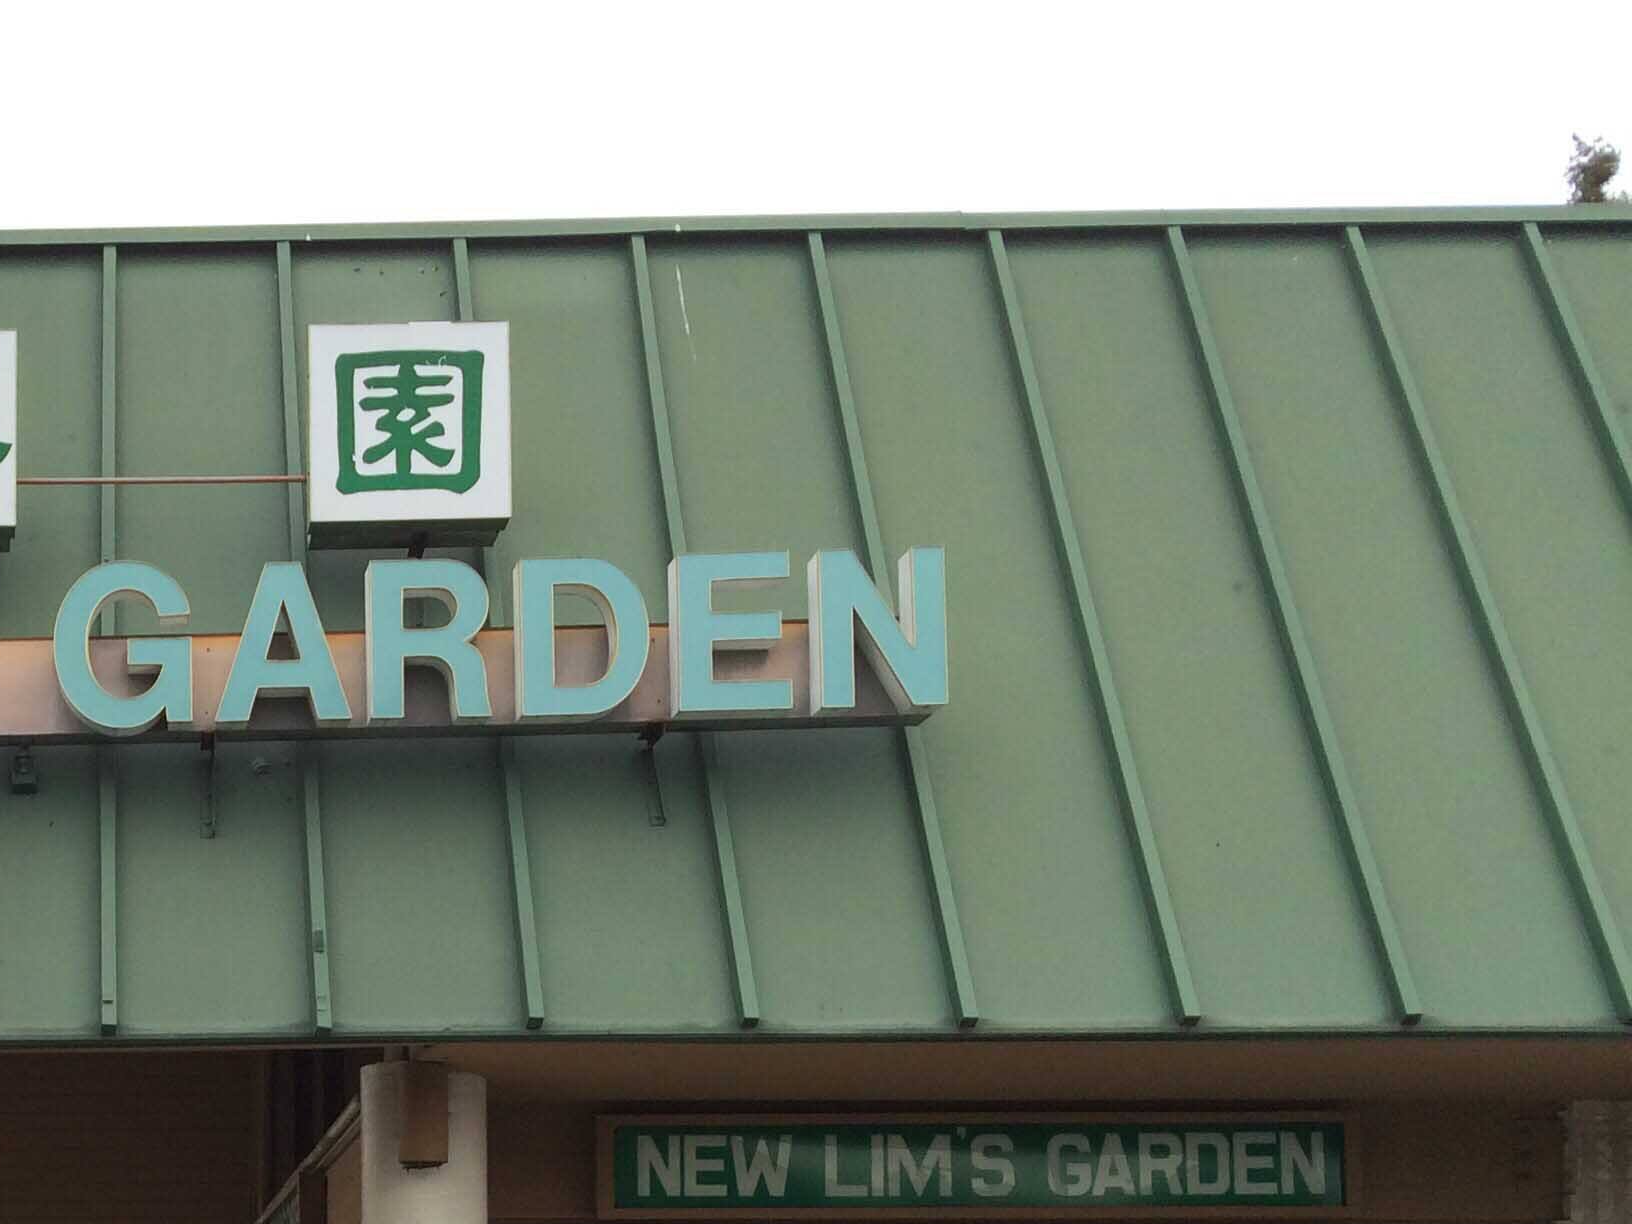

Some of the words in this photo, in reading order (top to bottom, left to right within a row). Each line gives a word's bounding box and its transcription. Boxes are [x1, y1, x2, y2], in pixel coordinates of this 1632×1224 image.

[335, 350, 485, 495] 園
[53, 546, 950, 736] GARDEN
[635, 1133, 792, 1197] NEW
[824, 1126, 1015, 1197] LIM'S
[1046, 1131, 1326, 1197] GARDEN
